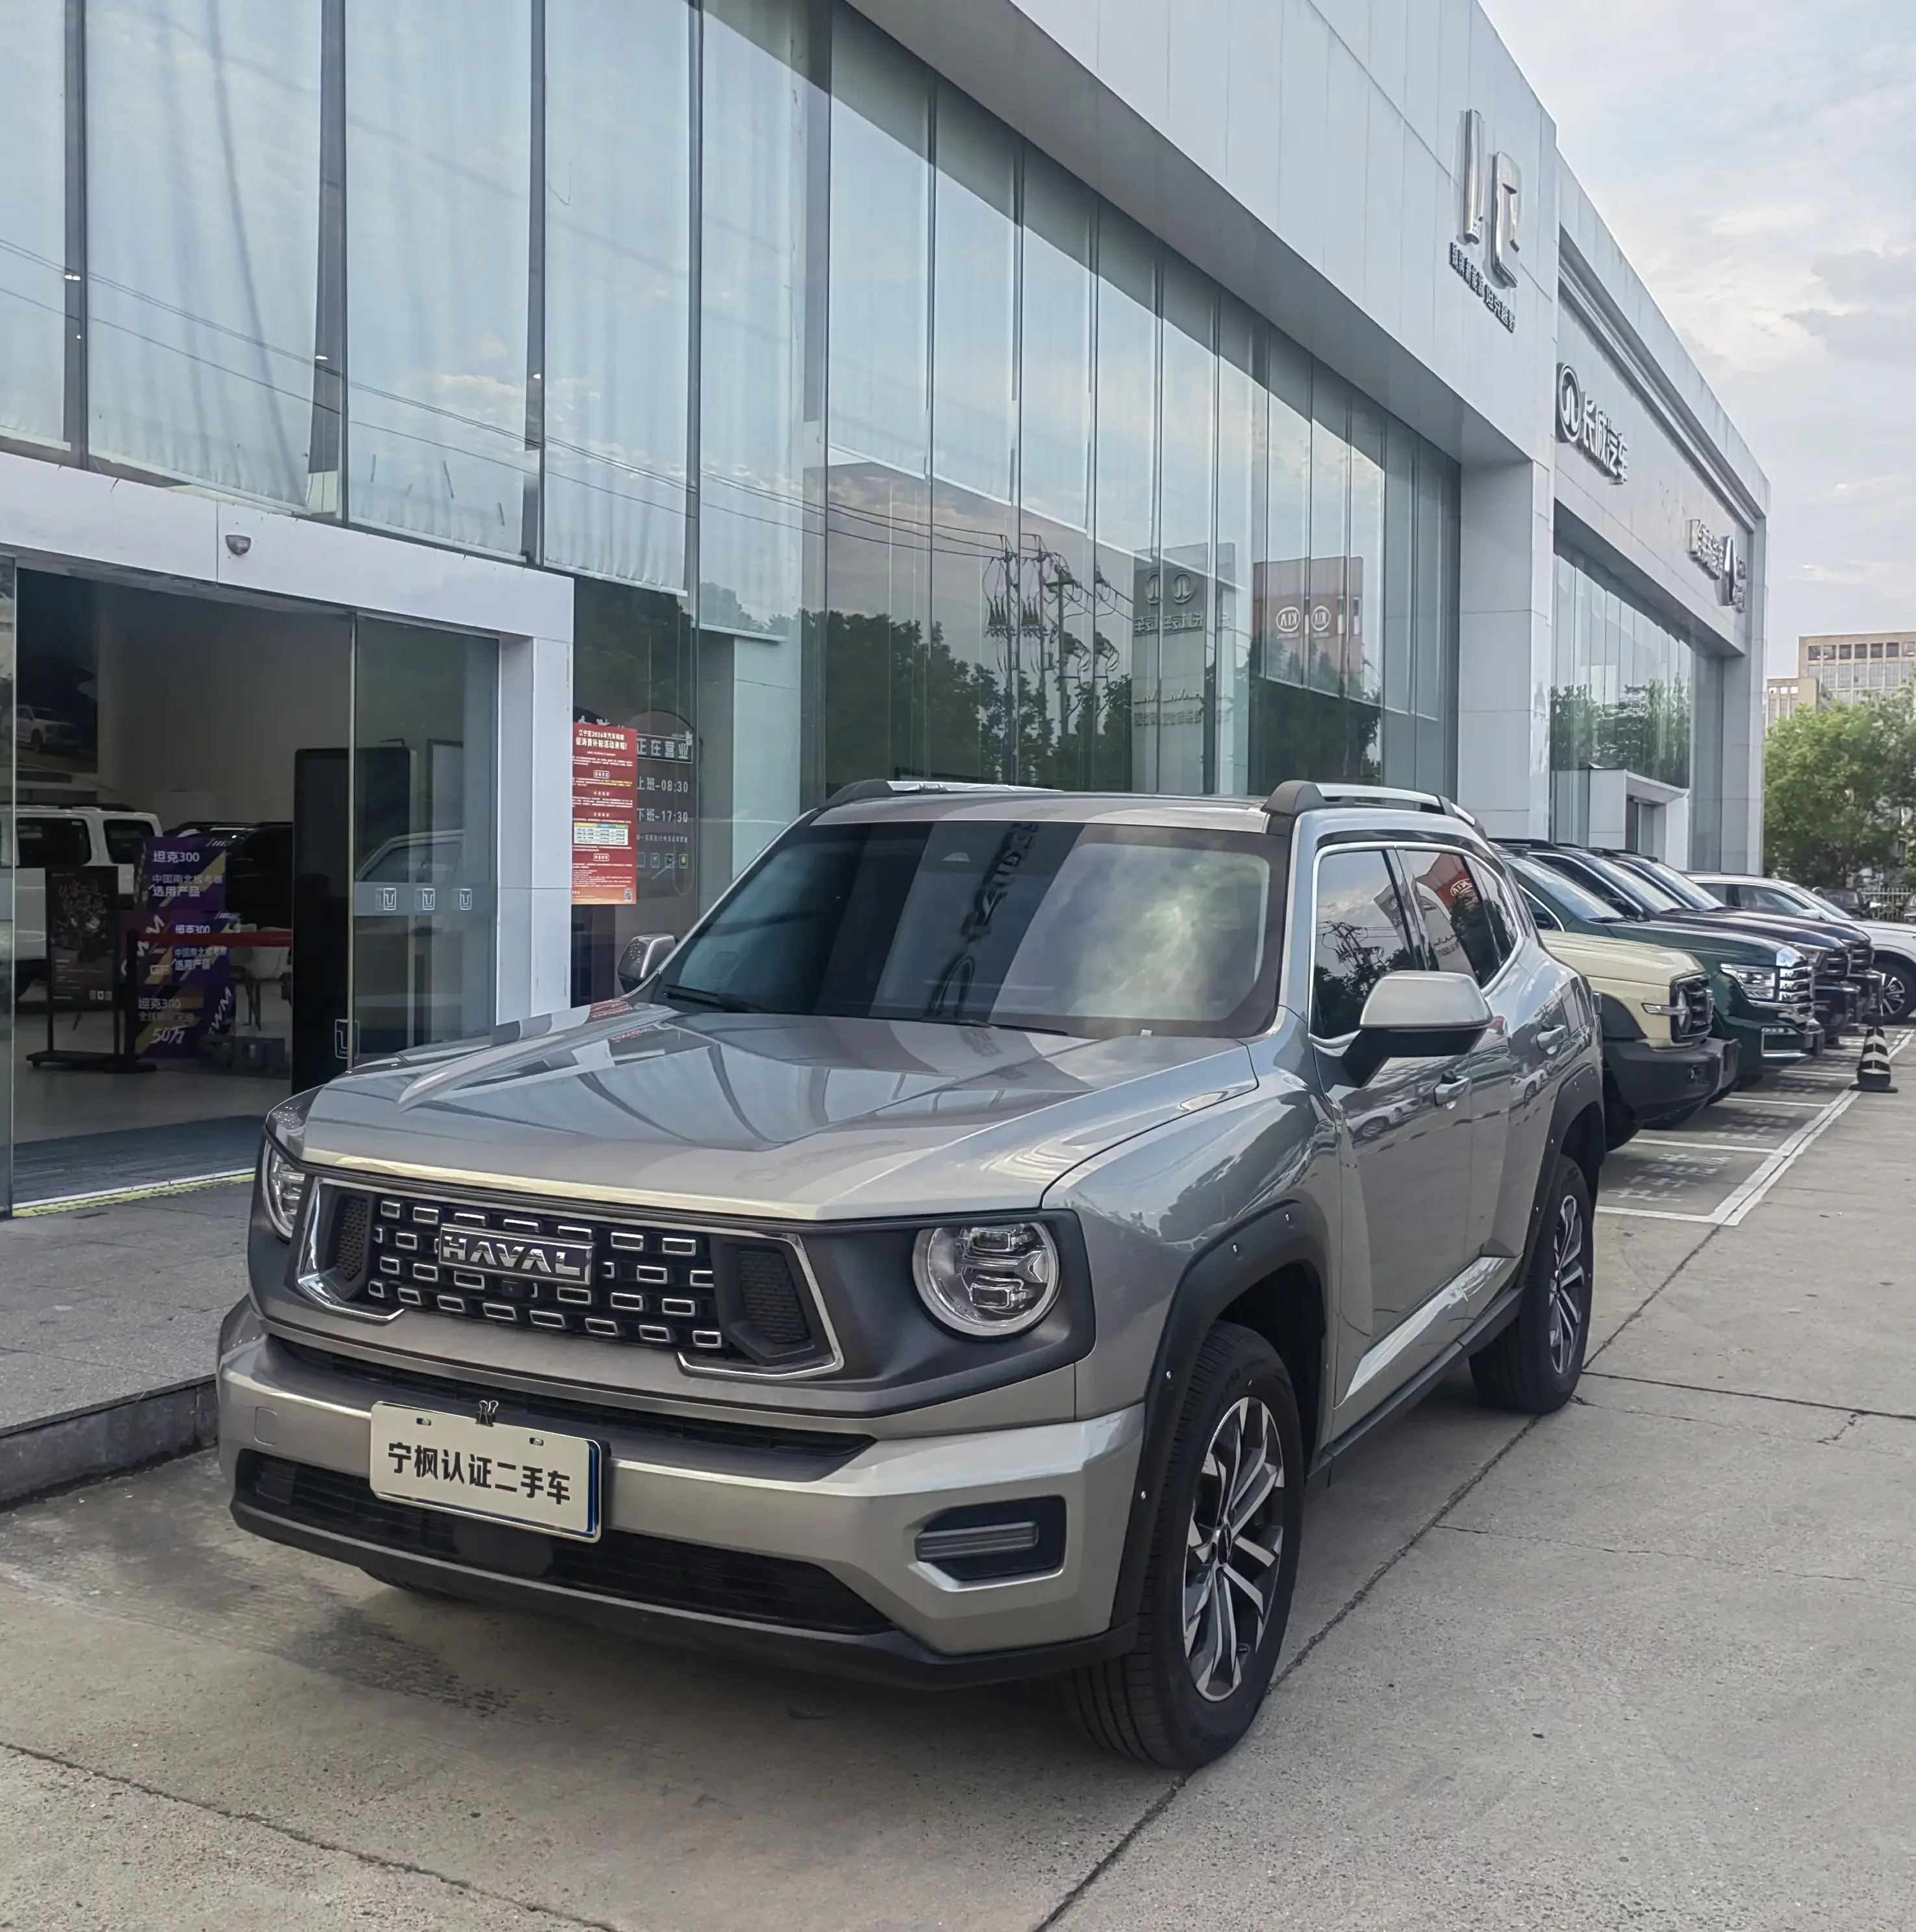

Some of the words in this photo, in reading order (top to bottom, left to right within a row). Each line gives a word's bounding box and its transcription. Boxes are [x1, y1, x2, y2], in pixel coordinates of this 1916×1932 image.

[636, 738, 688, 760] 正在营业
[152, 850, 200, 864] 坦克300
[152, 885, 201, 897] 选用产品
[138, 997, 181, 1010] 坦克300
[443, 1236, 581, 1276] HAVAL
[388, 1442, 571, 1505] 宁枫认证二手车
